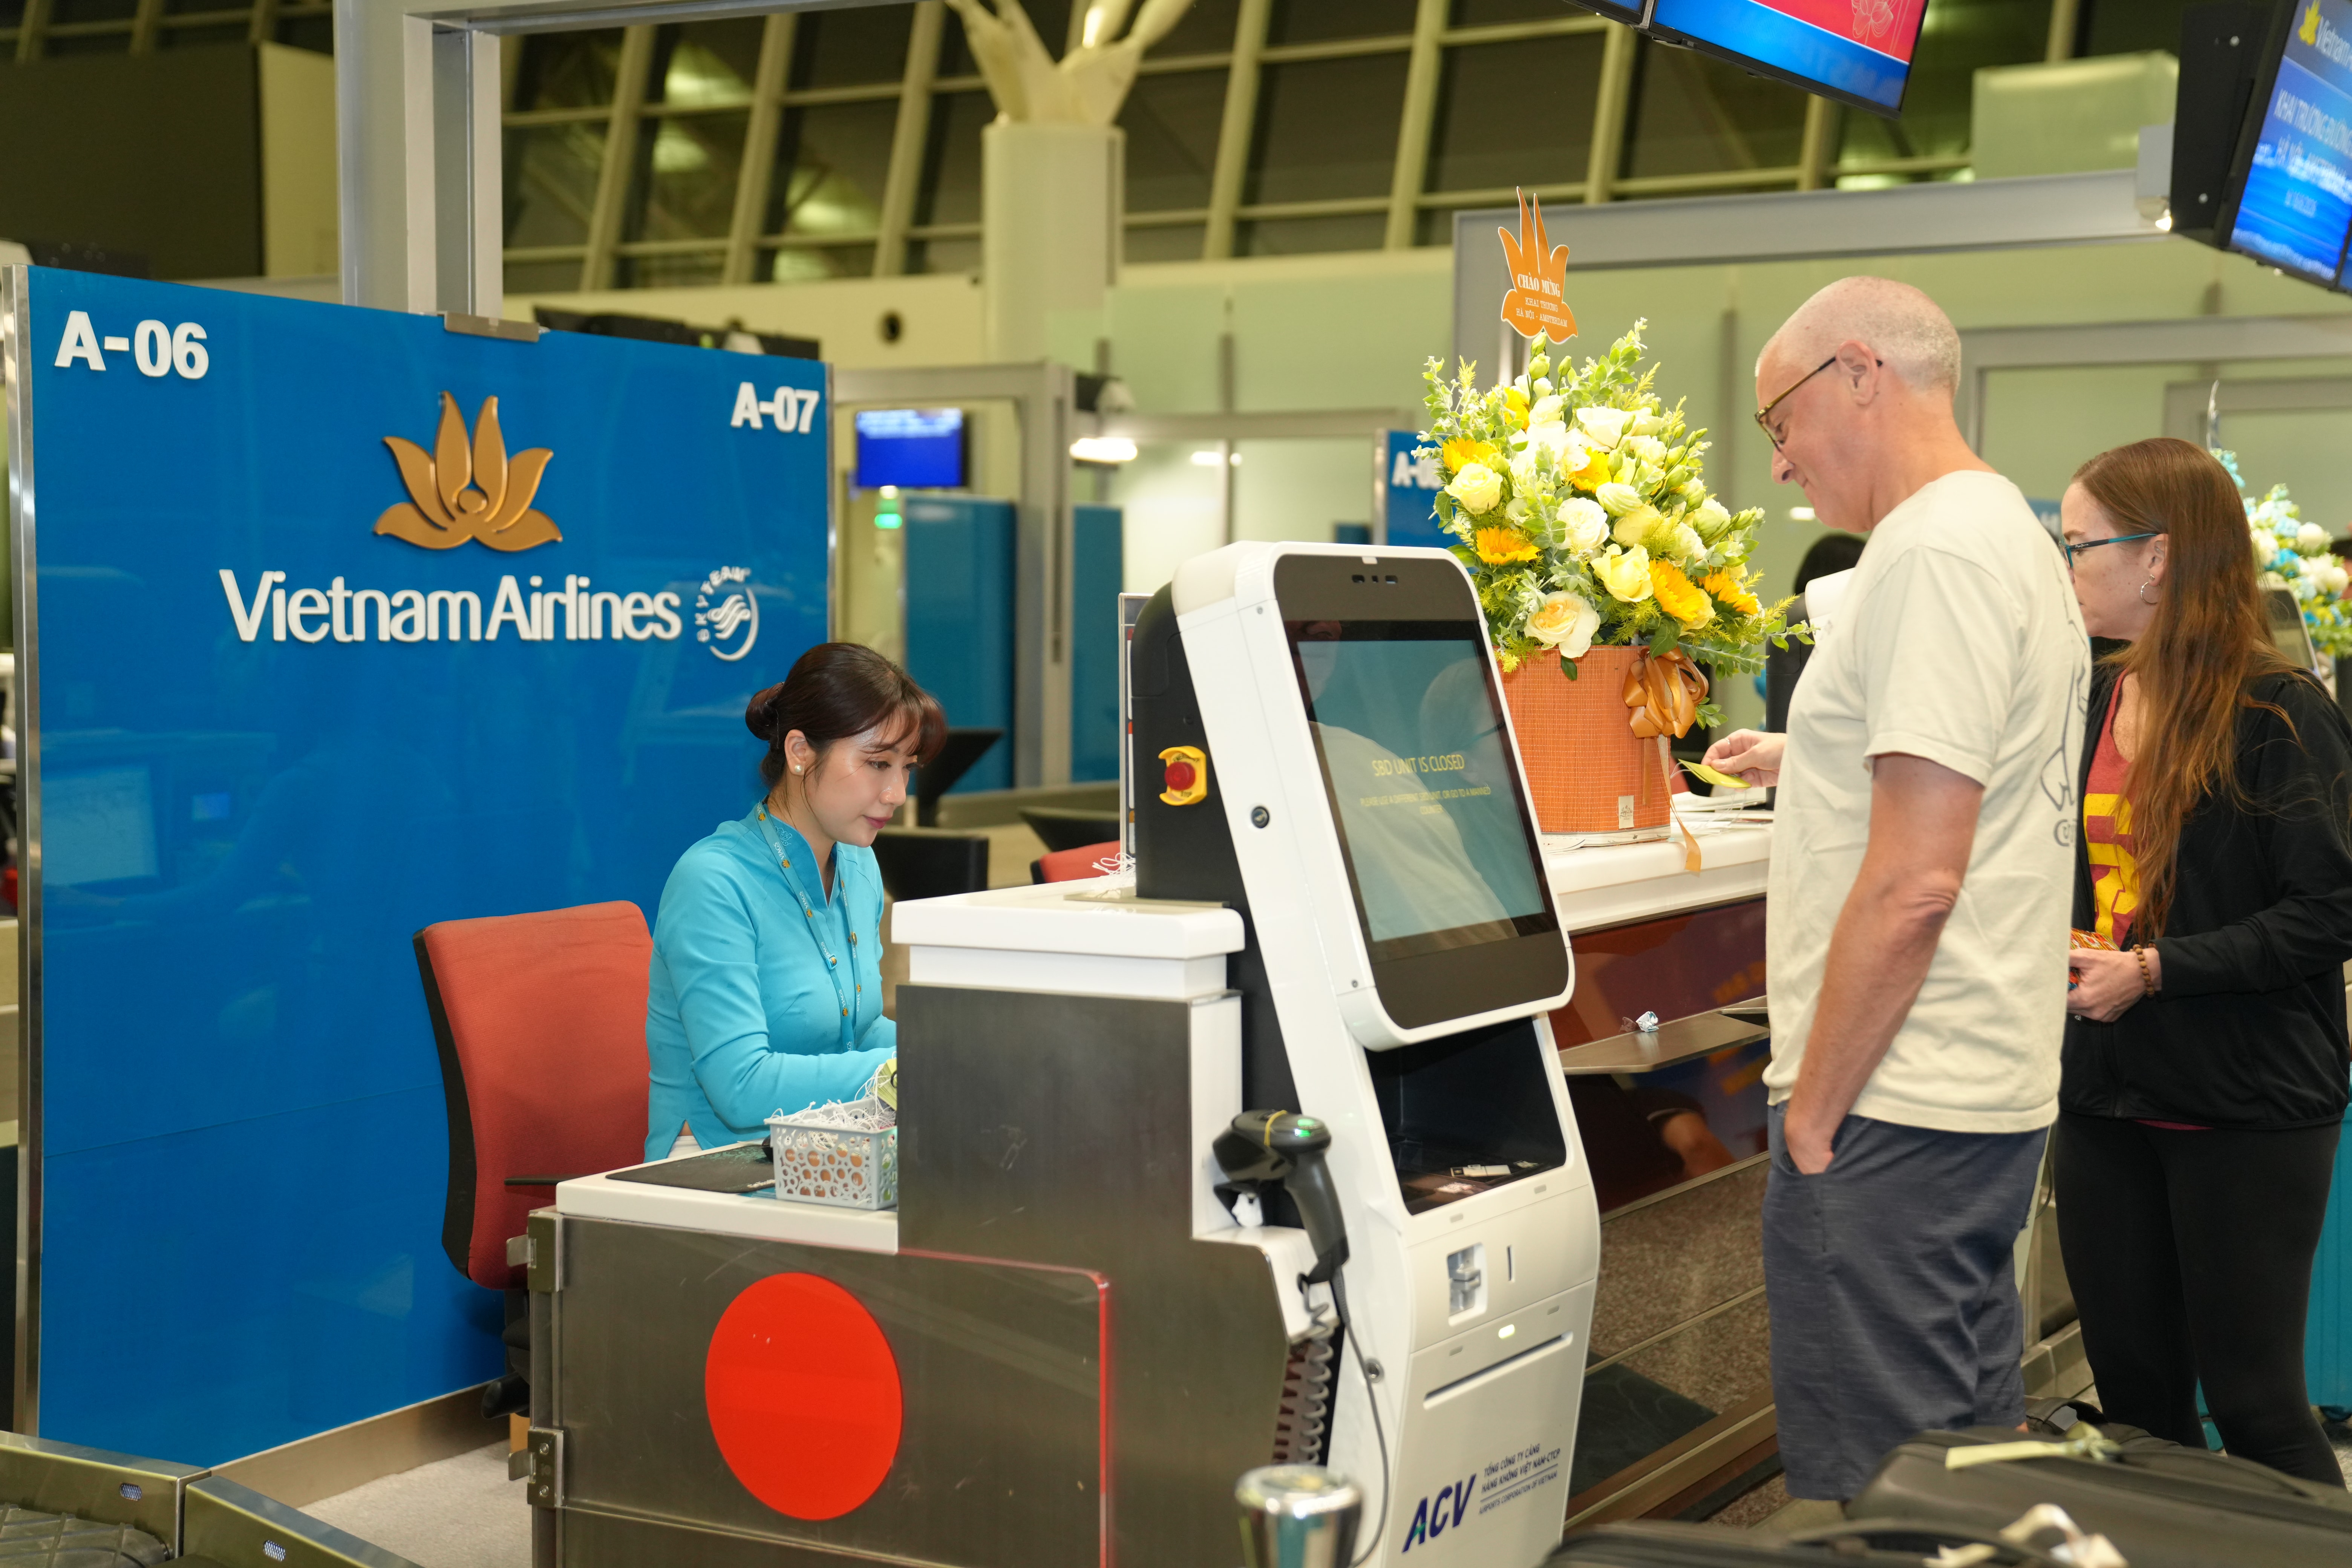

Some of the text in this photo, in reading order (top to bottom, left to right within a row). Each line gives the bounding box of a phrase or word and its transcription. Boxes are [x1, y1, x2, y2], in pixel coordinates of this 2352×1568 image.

[1517, 272, 1560, 297] CHÀO MỪNG
[1525, 297, 1539, 307] KHAI
[1516, 308, 1524, 317] HÀ
[1525, 309, 1534, 320] NỘI
[1539, 313, 1568, 327] AMSTERDAM
[54, 310, 210, 379] A-06
[730, 381, 820, 434] A-07
[219, 568, 681, 643] Vietnam Airlines
[1372, 754, 1465, 776] SBD UNIT IS CLOSED
[773, 842, 784, 860] VIAGS
[799, 891, 808, 909] VIAGS
[1500, 1454, 1516, 1470] CÔNG
[1517, 1449, 1524, 1462] TY
[1478, 1470, 1558, 1515] AIRPORTS CORPORATION OF VIETNAM
[1401, 1473, 1477, 1553] ACV
